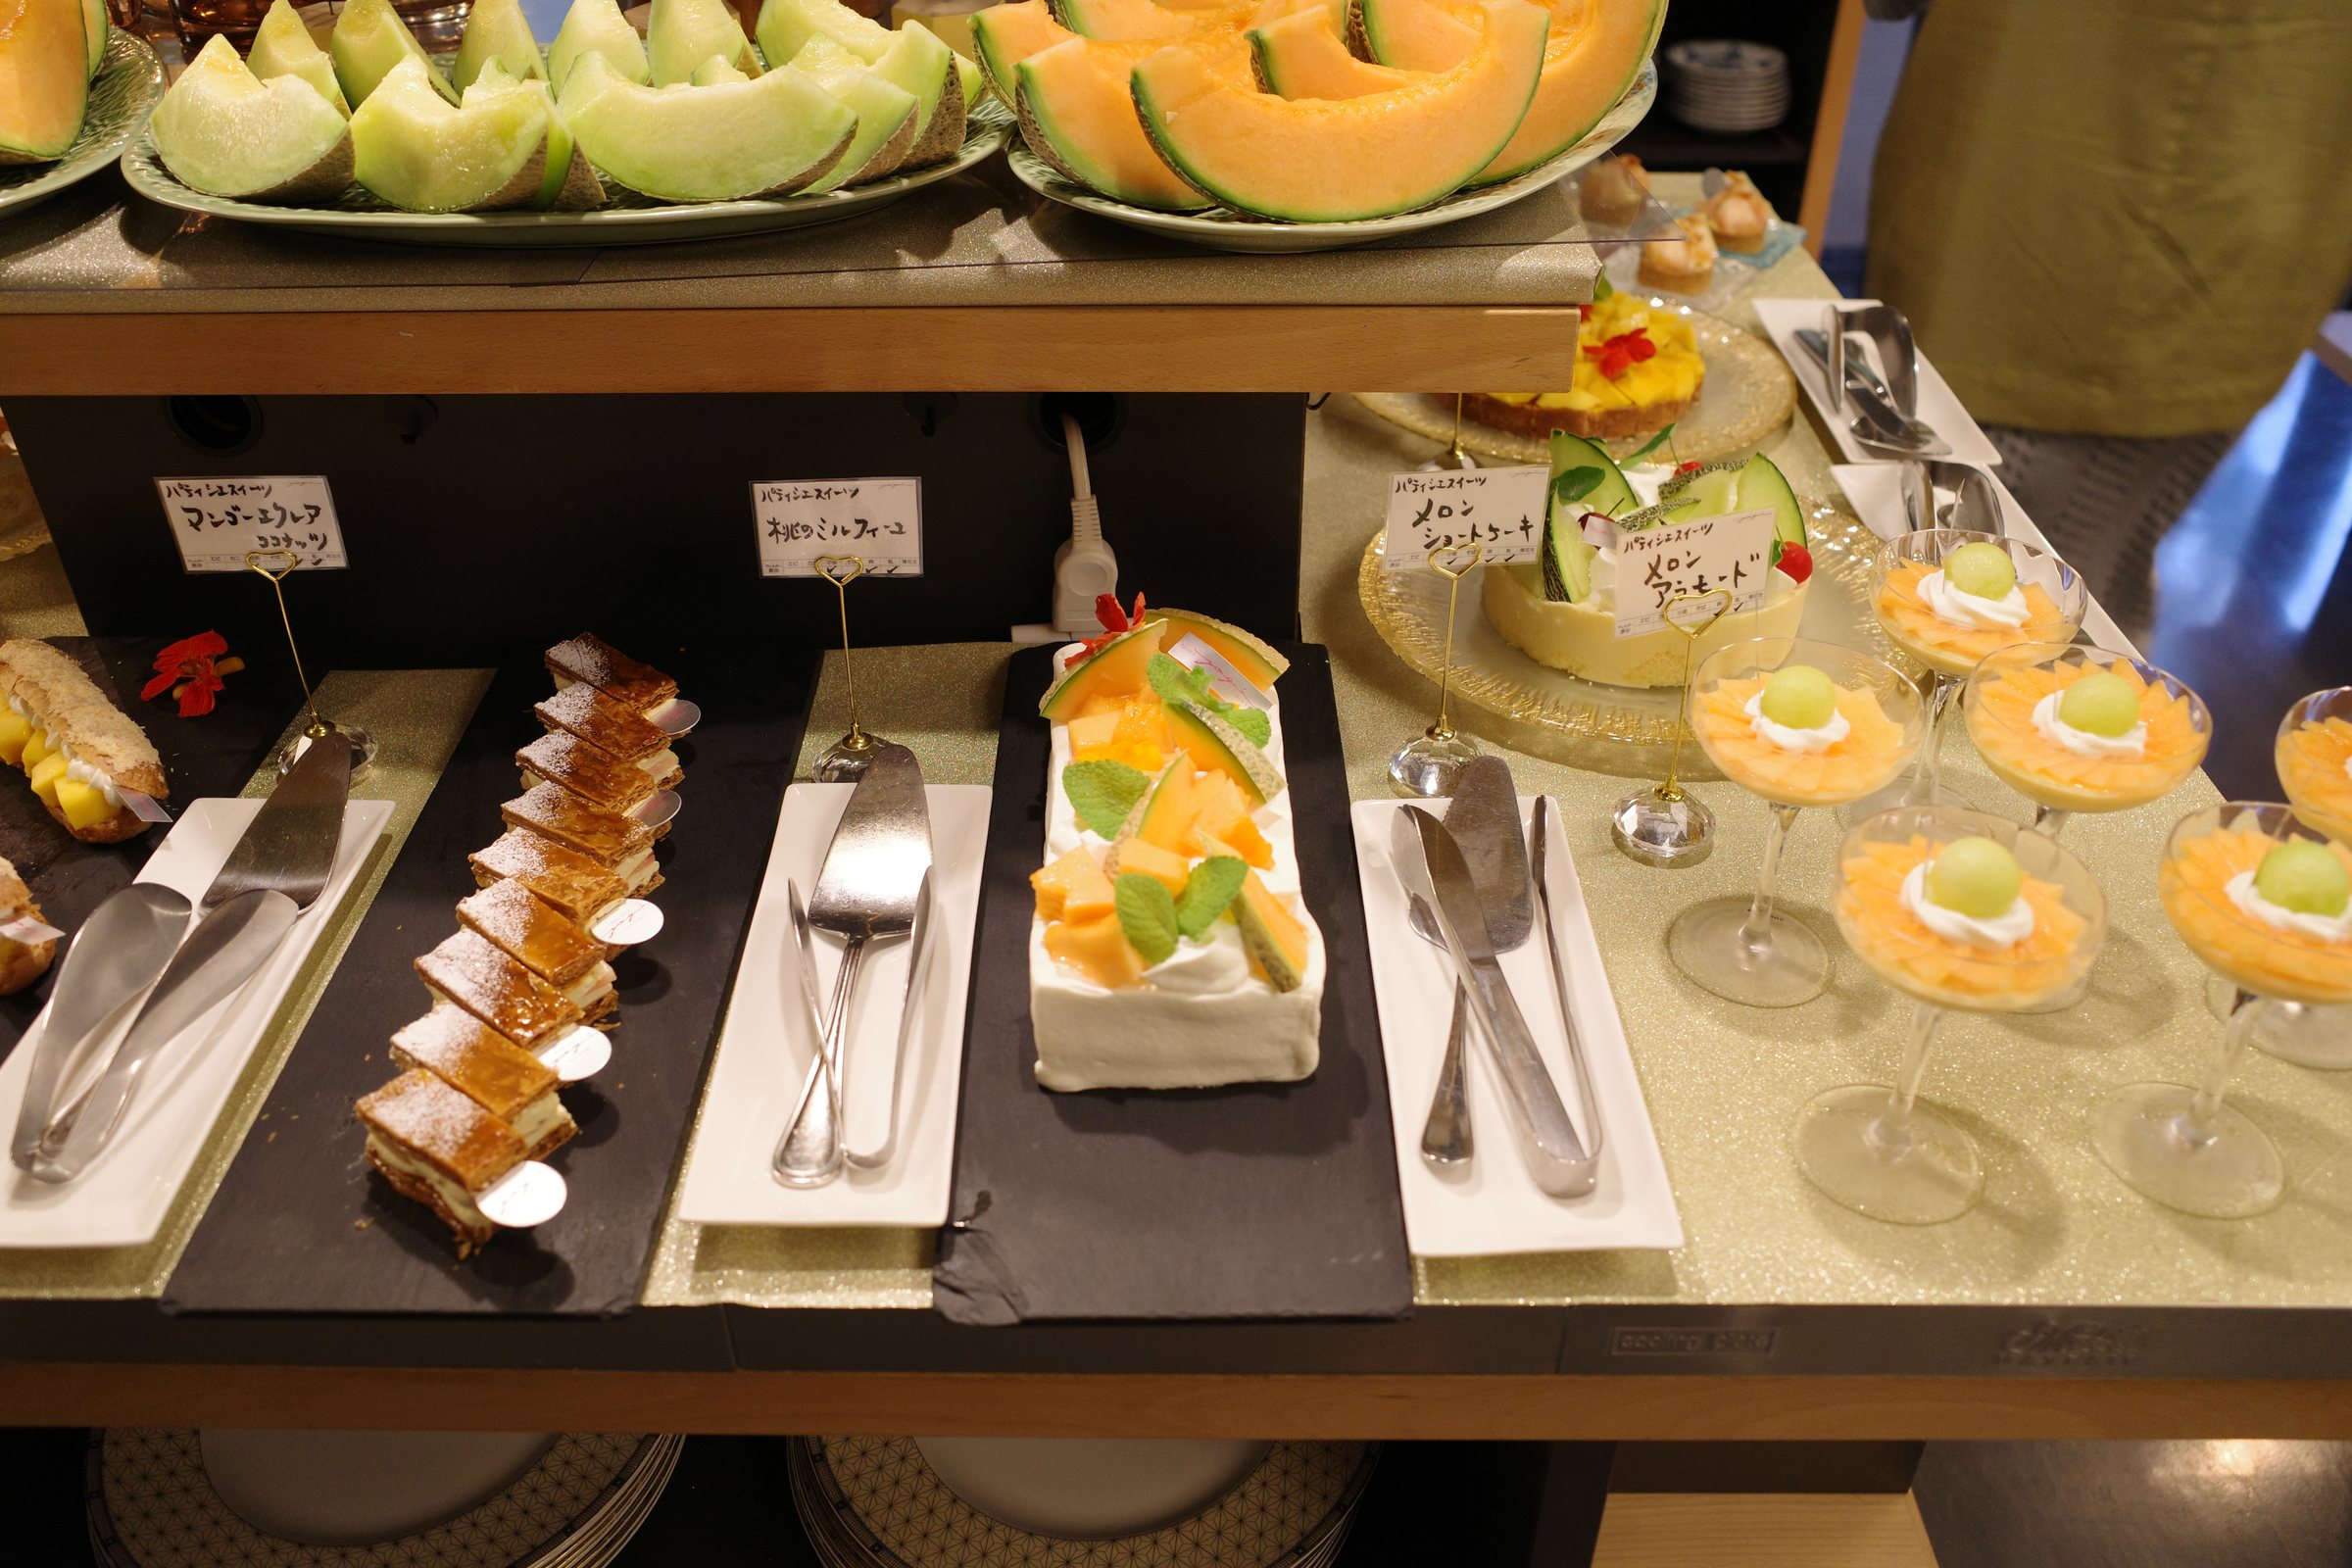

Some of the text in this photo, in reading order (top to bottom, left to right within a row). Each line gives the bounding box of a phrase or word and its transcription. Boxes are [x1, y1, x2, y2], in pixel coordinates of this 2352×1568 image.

[180, 501, 321, 532] マンゴーエクレア
[1411, 498, 1474, 528] メロン
[256, 532, 328, 551] ココナッツ
[766, 516, 906, 544] 桃のミルフィーユ
[1423, 514, 1534, 550] ショートケーキ
[1643, 551, 1702, 586] メロン
[1651, 553, 1760, 609] アラモード
